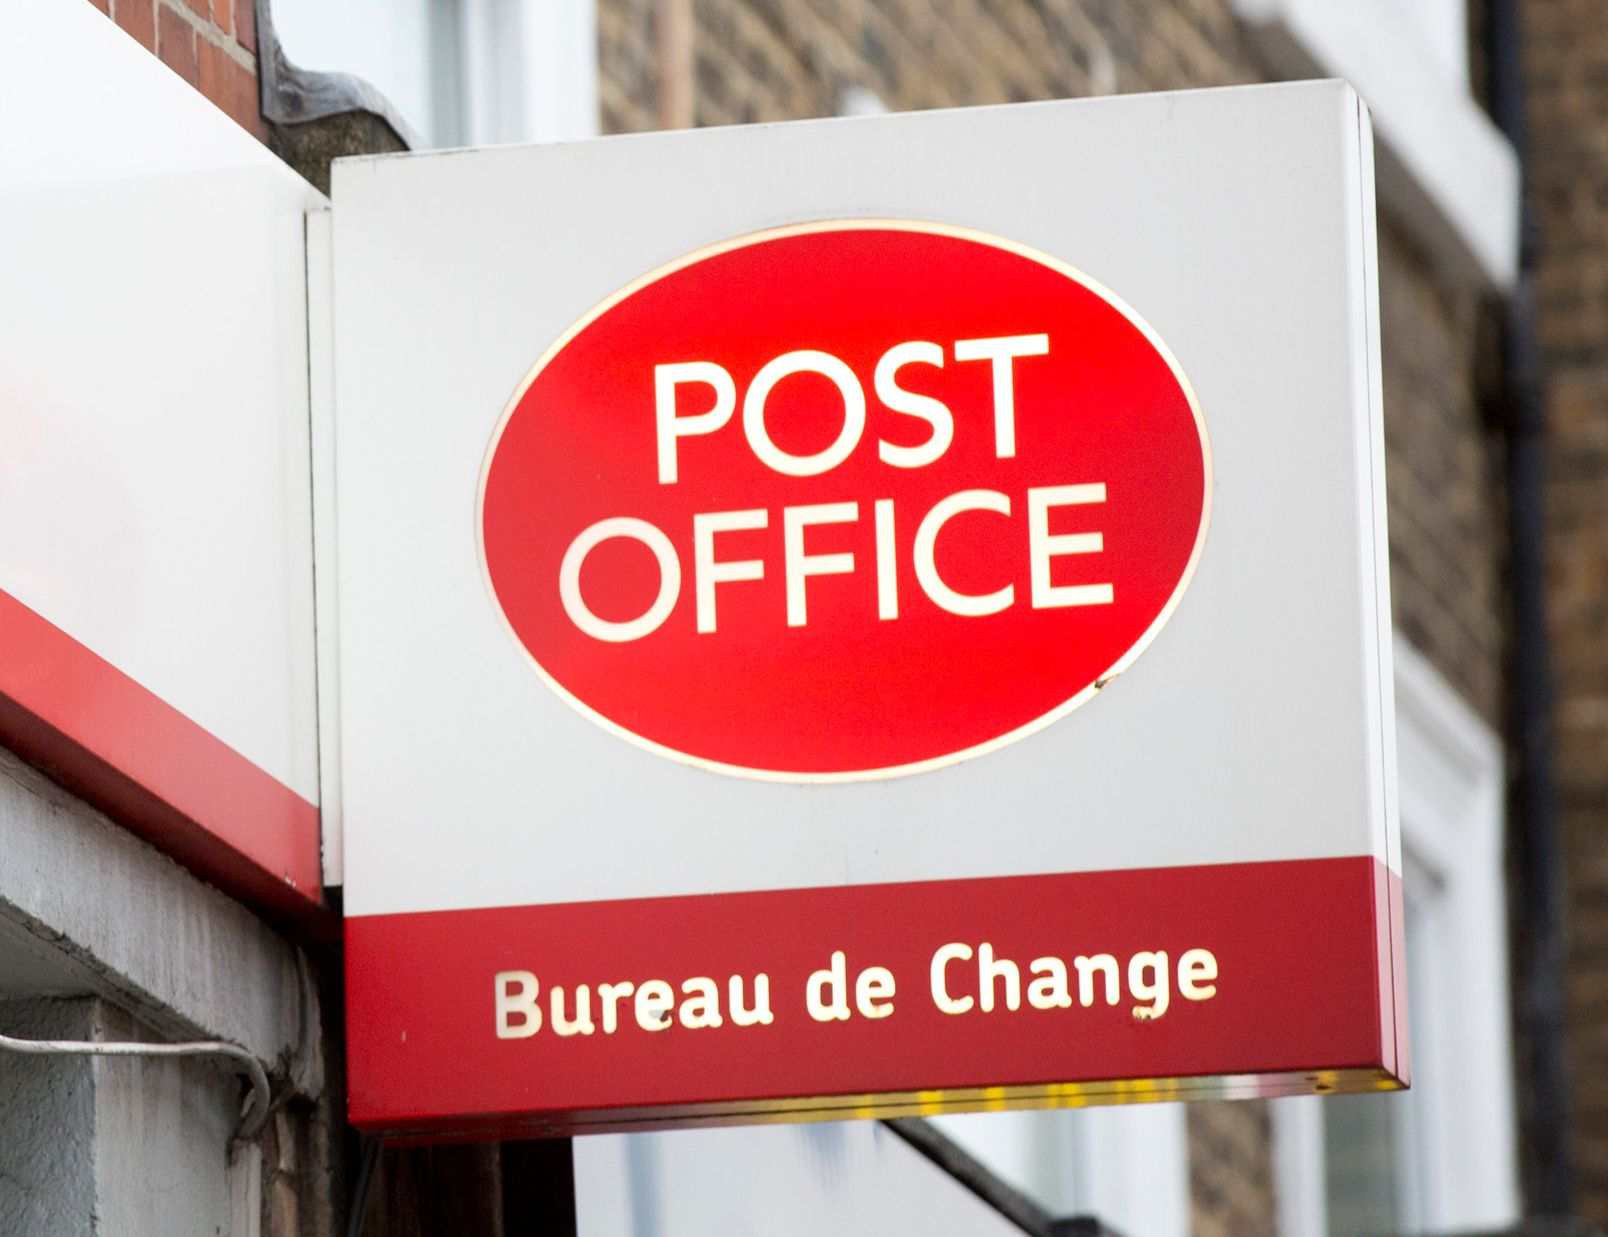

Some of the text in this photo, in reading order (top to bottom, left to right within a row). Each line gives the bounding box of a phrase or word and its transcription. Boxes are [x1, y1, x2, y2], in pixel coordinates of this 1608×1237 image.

[654, 333, 1050, 485] POST
[558, 482, 1114, 643] OFFICE
[494, 942, 1219, 1039] Bureau de Change
